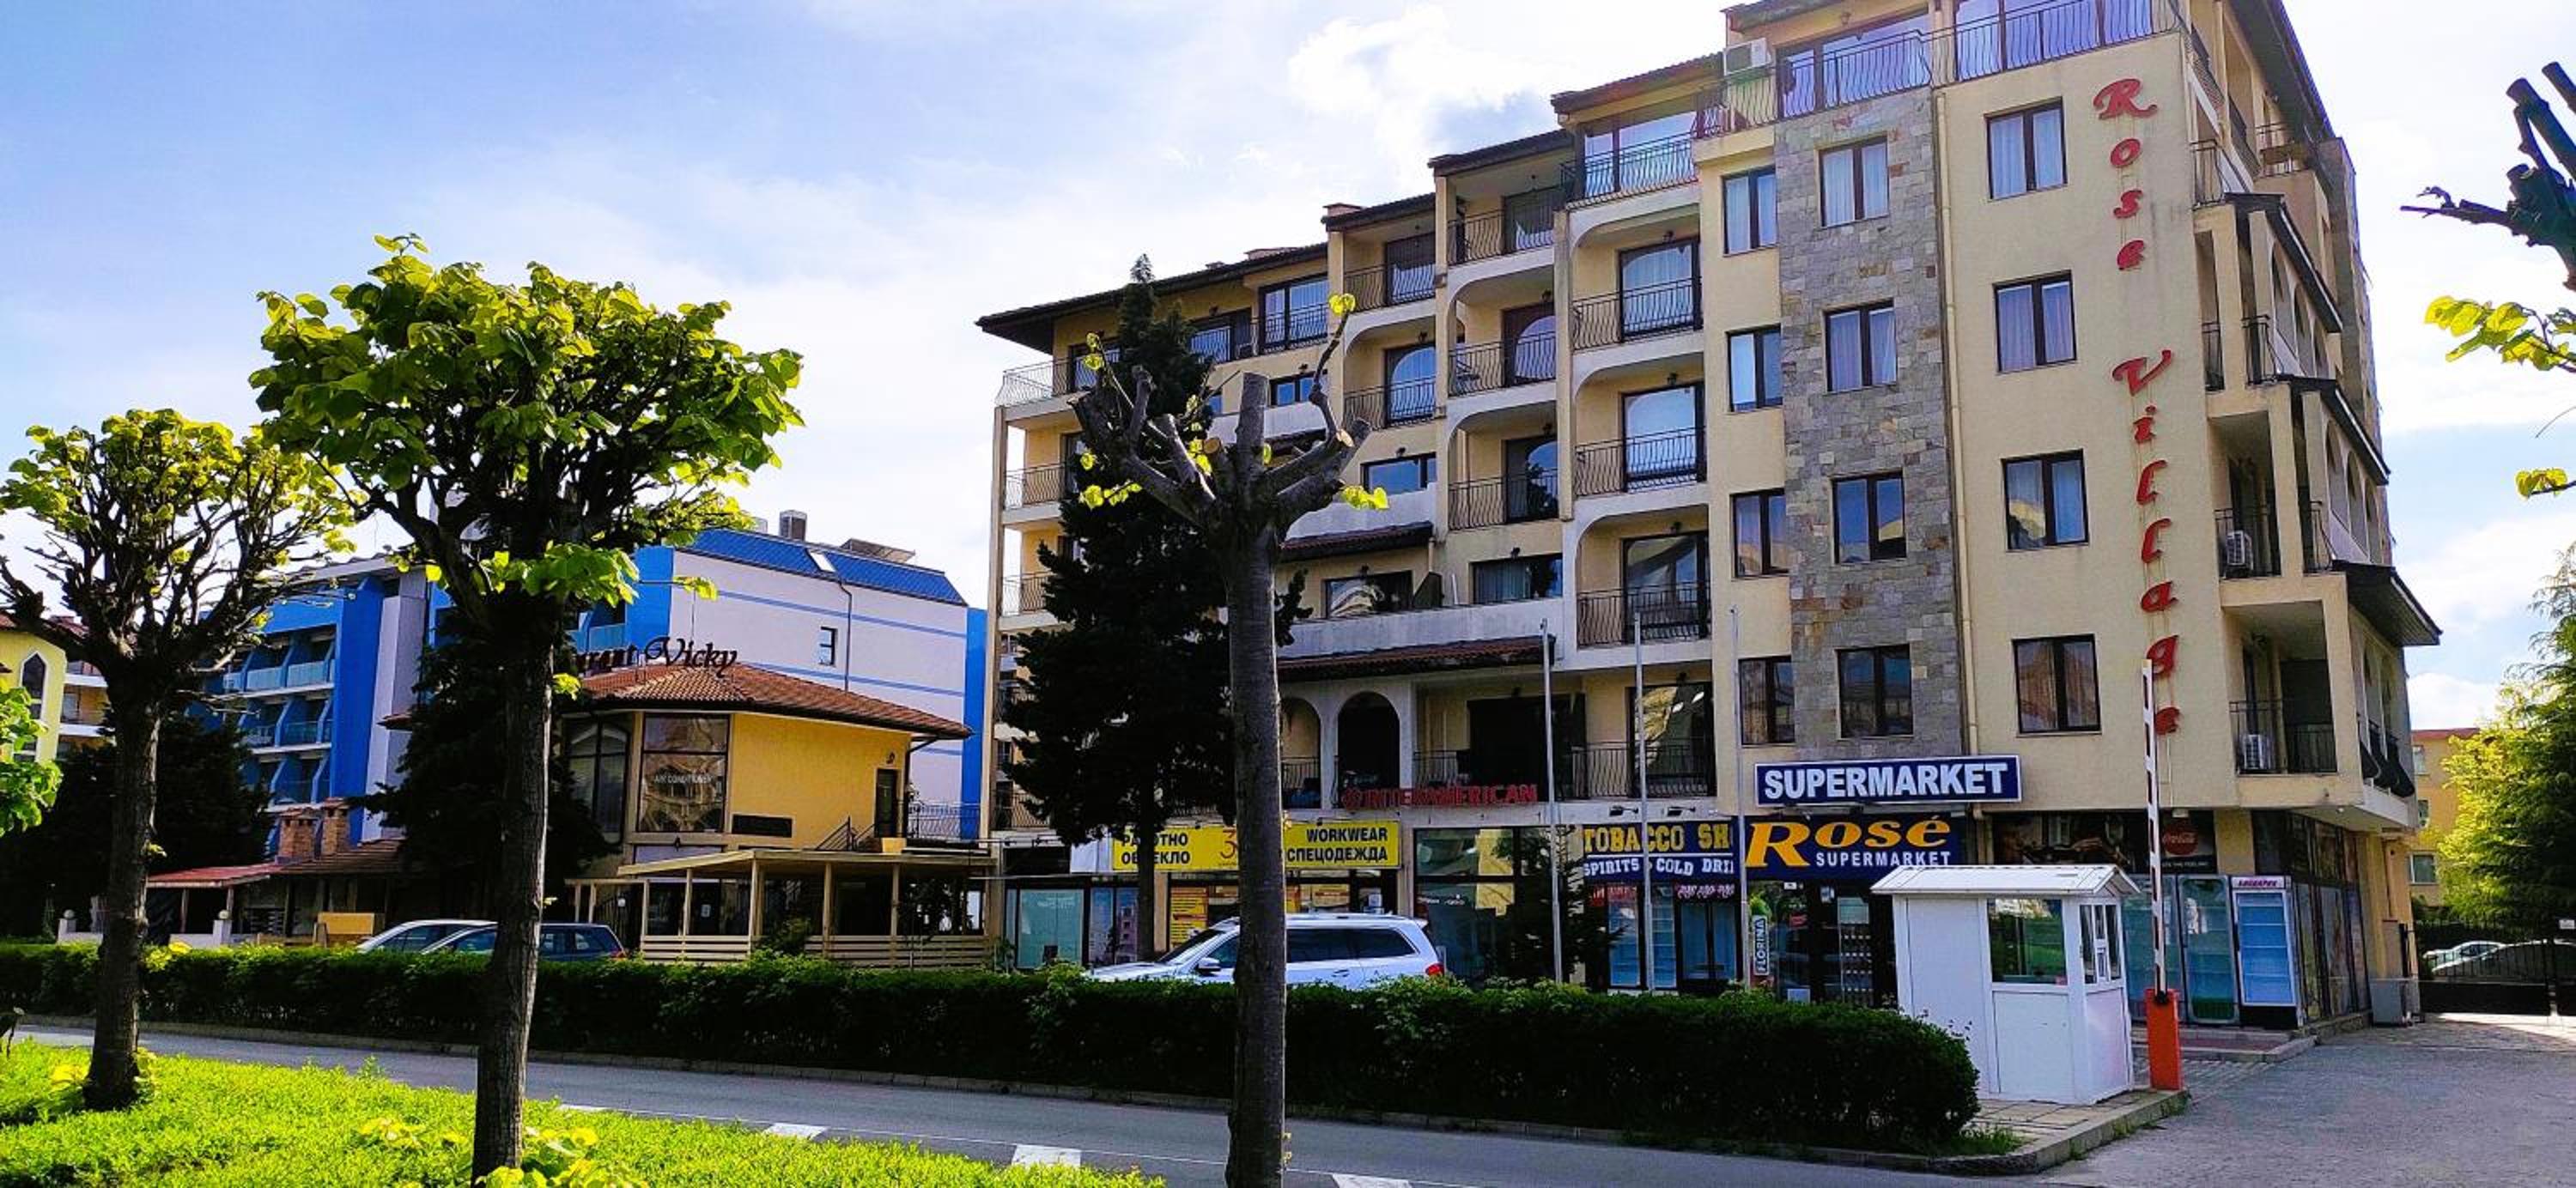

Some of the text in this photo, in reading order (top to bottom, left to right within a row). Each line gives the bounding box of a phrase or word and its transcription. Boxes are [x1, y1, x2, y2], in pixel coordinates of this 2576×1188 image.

[2093, 77, 2181, 736] Rose Village
[644, 635, 738, 678] Vicky
[1764, 762, 2008, 800] SUPERMARKET
[1121, 832, 1188, 847] РАОТНО
[1306, 827, 1388, 842] WORKWEAR
[1583, 823, 1732, 853] TOBACCO SH
[1744, 814, 1952, 869] Rosé
[1121, 849, 1191, 865] ОБЕКЛО
[1287, 846, 1388, 864] СПЕЦОДЕЖДА
[1584, 858, 1735, 876] SPIRITS COLD DRI
[1815, 851, 1952, 868] SUPERMARKET
[1755, 918, 1767, 972] FLORINA
